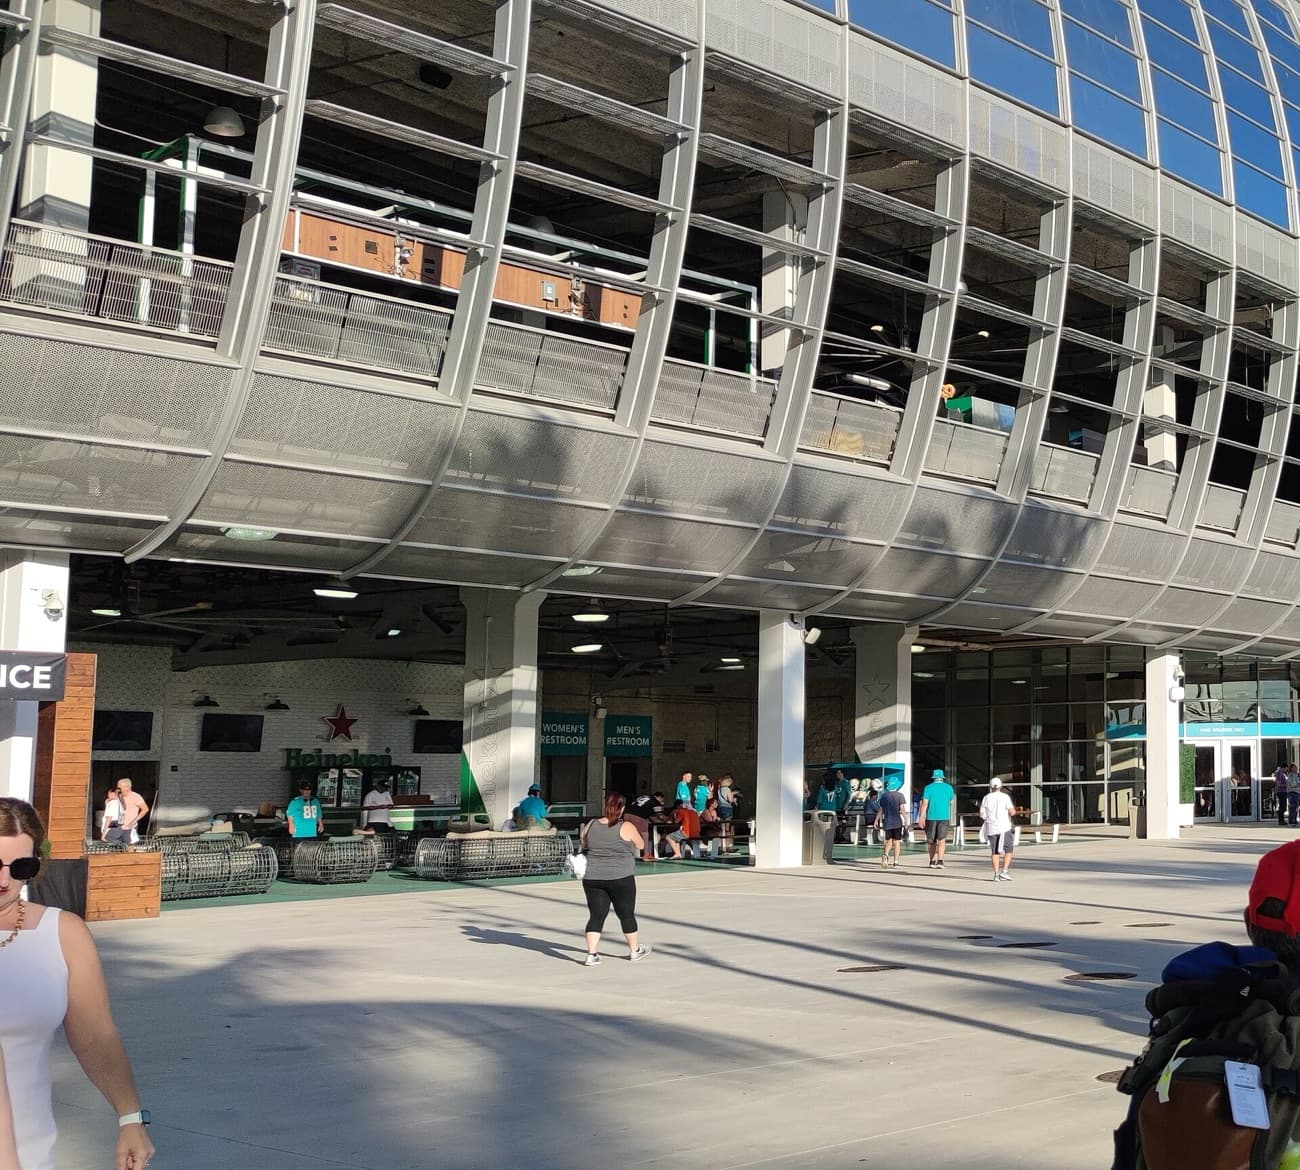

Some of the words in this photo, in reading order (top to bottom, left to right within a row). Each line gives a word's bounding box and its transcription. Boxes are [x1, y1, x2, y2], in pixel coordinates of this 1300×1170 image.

[542, 723, 585, 733] WOMEN'S
[616, 725, 641, 735] MEN'S
[540, 735, 587, 745] RESTROOM
[606, 736, 650, 746] RESTROOM
